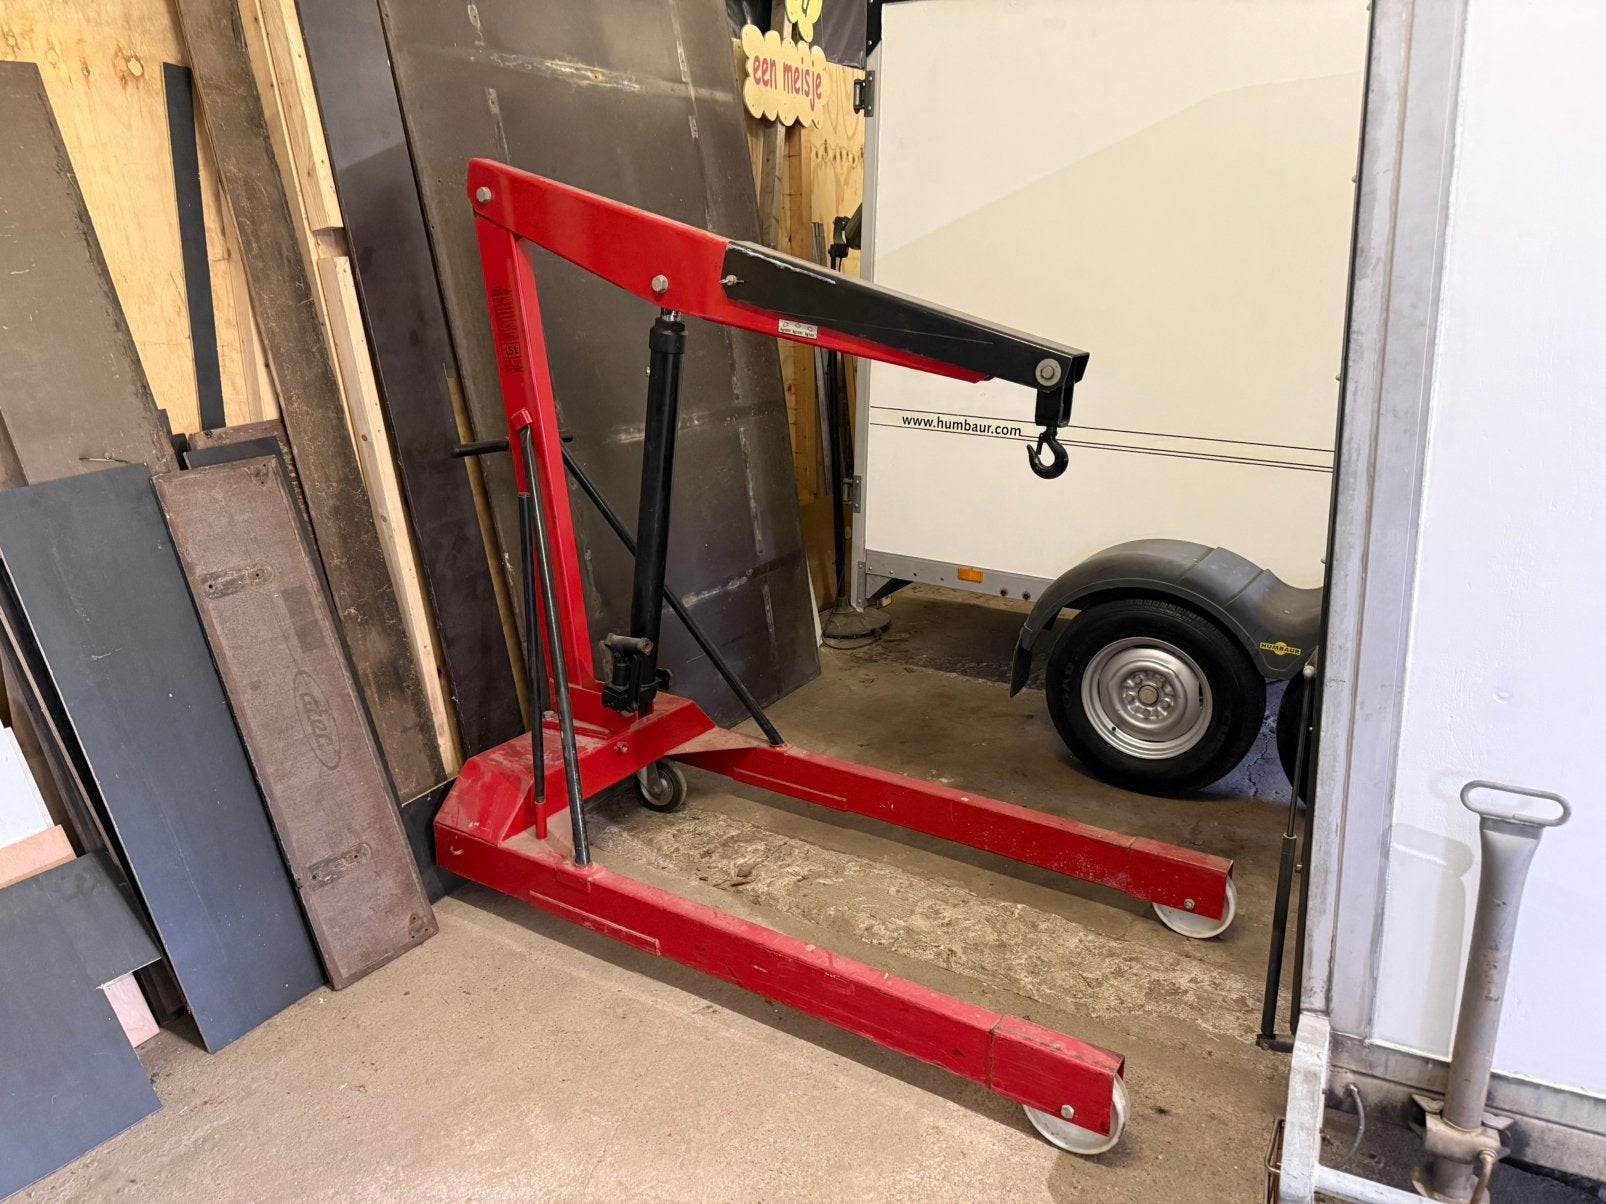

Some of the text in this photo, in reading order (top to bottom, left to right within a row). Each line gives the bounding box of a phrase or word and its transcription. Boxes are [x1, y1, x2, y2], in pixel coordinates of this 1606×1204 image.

[753, 55, 822, 112] een meisje
[902, 416, 1021, 437] www.humbaur.com
[1261, 643, 1300, 654] HUMBAUR
